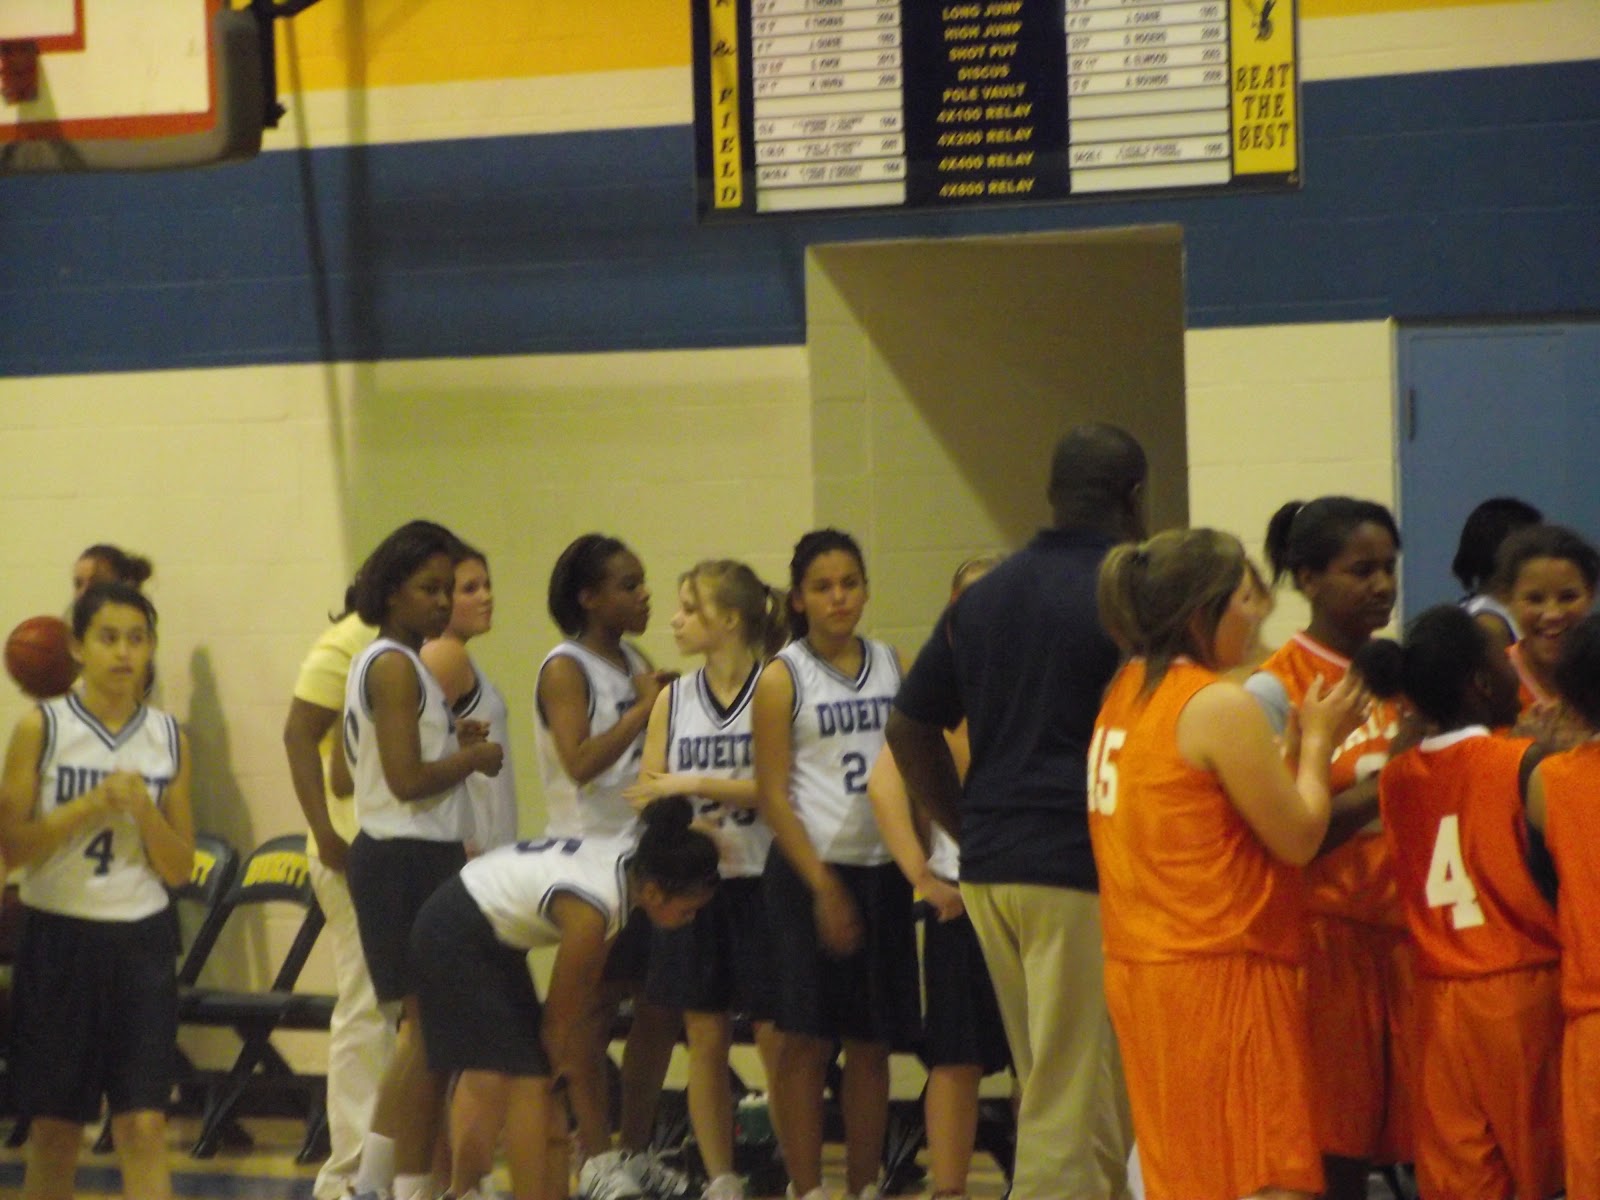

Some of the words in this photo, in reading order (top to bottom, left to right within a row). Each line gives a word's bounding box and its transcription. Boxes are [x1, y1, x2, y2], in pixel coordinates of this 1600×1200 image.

[942, 5, 980, 20] LONG
[984, 0, 1023, 17] JUMP
[944, 25, 979, 40] HIGH
[983, 21, 1023, 37] JUMP
[949, 45, 986, 61] SHOT
[958, 64, 1010, 80] DISCUS
[1236, 63, 1291, 92] BEAT
[943, 86, 979, 102] POLE
[981, 82, 1027, 100] VAULT
[937, 106, 982, 122] 4X100
[986, 102, 1032, 120] RELAY
[1242, 93, 1285, 119] THE
[937, 130, 983, 146] 4X200
[986, 126, 1034, 144] RELAY
[1238, 122, 1290, 150] BEST
[938, 154, 984, 171] 4X400
[987, 150, 1035, 168] RELAY
[939, 181, 985, 197] 4X800
[988, 177, 1036, 194] RELAY
[842, 752, 867, 795] 2
[84, 828, 114, 876] 4
[1426, 815, 1485, 930] 4
